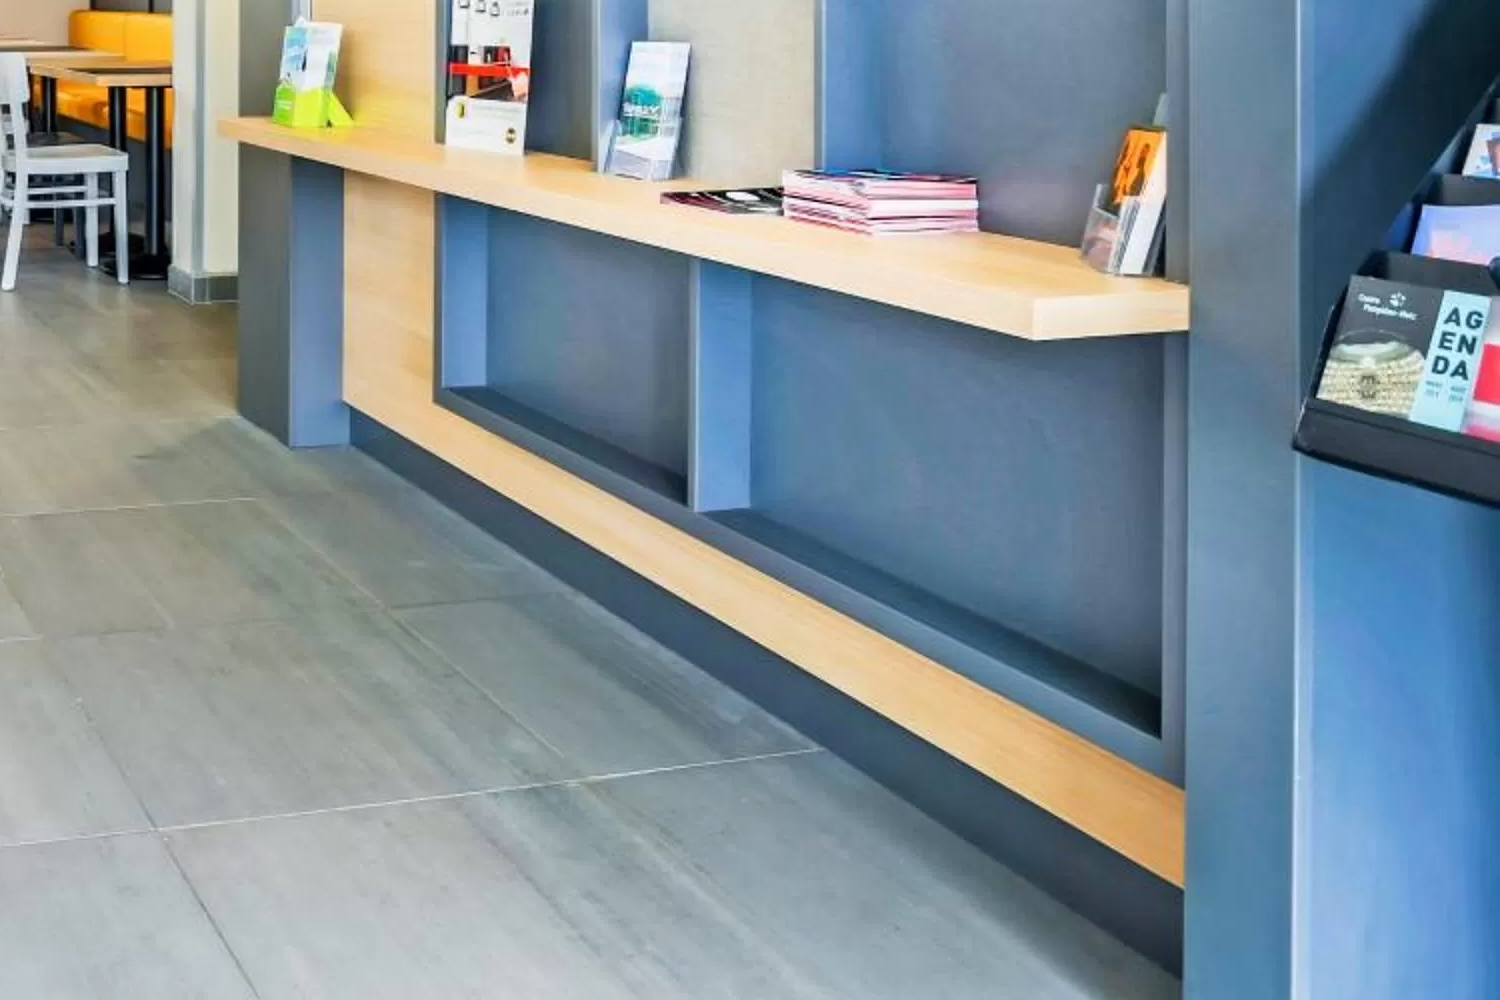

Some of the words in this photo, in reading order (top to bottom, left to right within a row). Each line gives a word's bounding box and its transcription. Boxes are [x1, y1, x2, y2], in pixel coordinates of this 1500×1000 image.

[1443, 306, 1485, 330] AG
[1438, 330, 1478, 356] EN
[1431, 355, 1469, 381] DA
